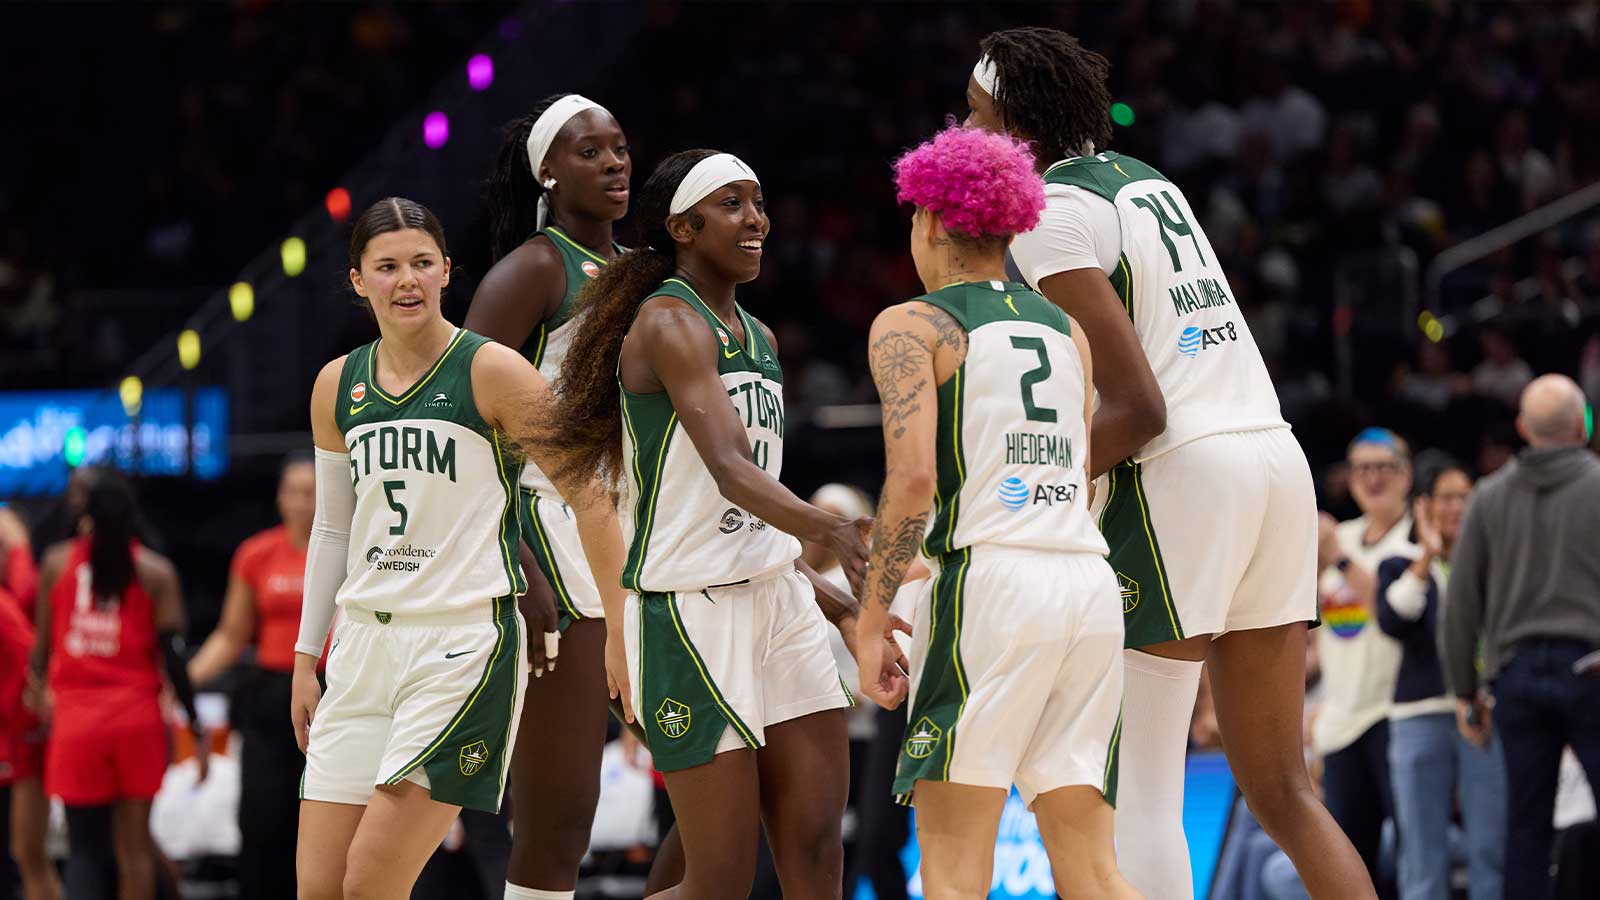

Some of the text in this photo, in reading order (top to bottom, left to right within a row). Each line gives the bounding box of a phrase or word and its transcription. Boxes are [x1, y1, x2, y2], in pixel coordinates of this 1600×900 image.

[1130, 190, 1206, 272] 14
[1168, 278, 1230, 317] MALONGA
[1009, 335, 1057, 423] 2
[350, 426, 457, 488] STORM
[1005, 432, 1072, 468] HIEDEMAN
[383, 480, 408, 536] 5
[1033, 483, 1078, 507] AT&T
[376, 560, 420, 572] SWEDISH
